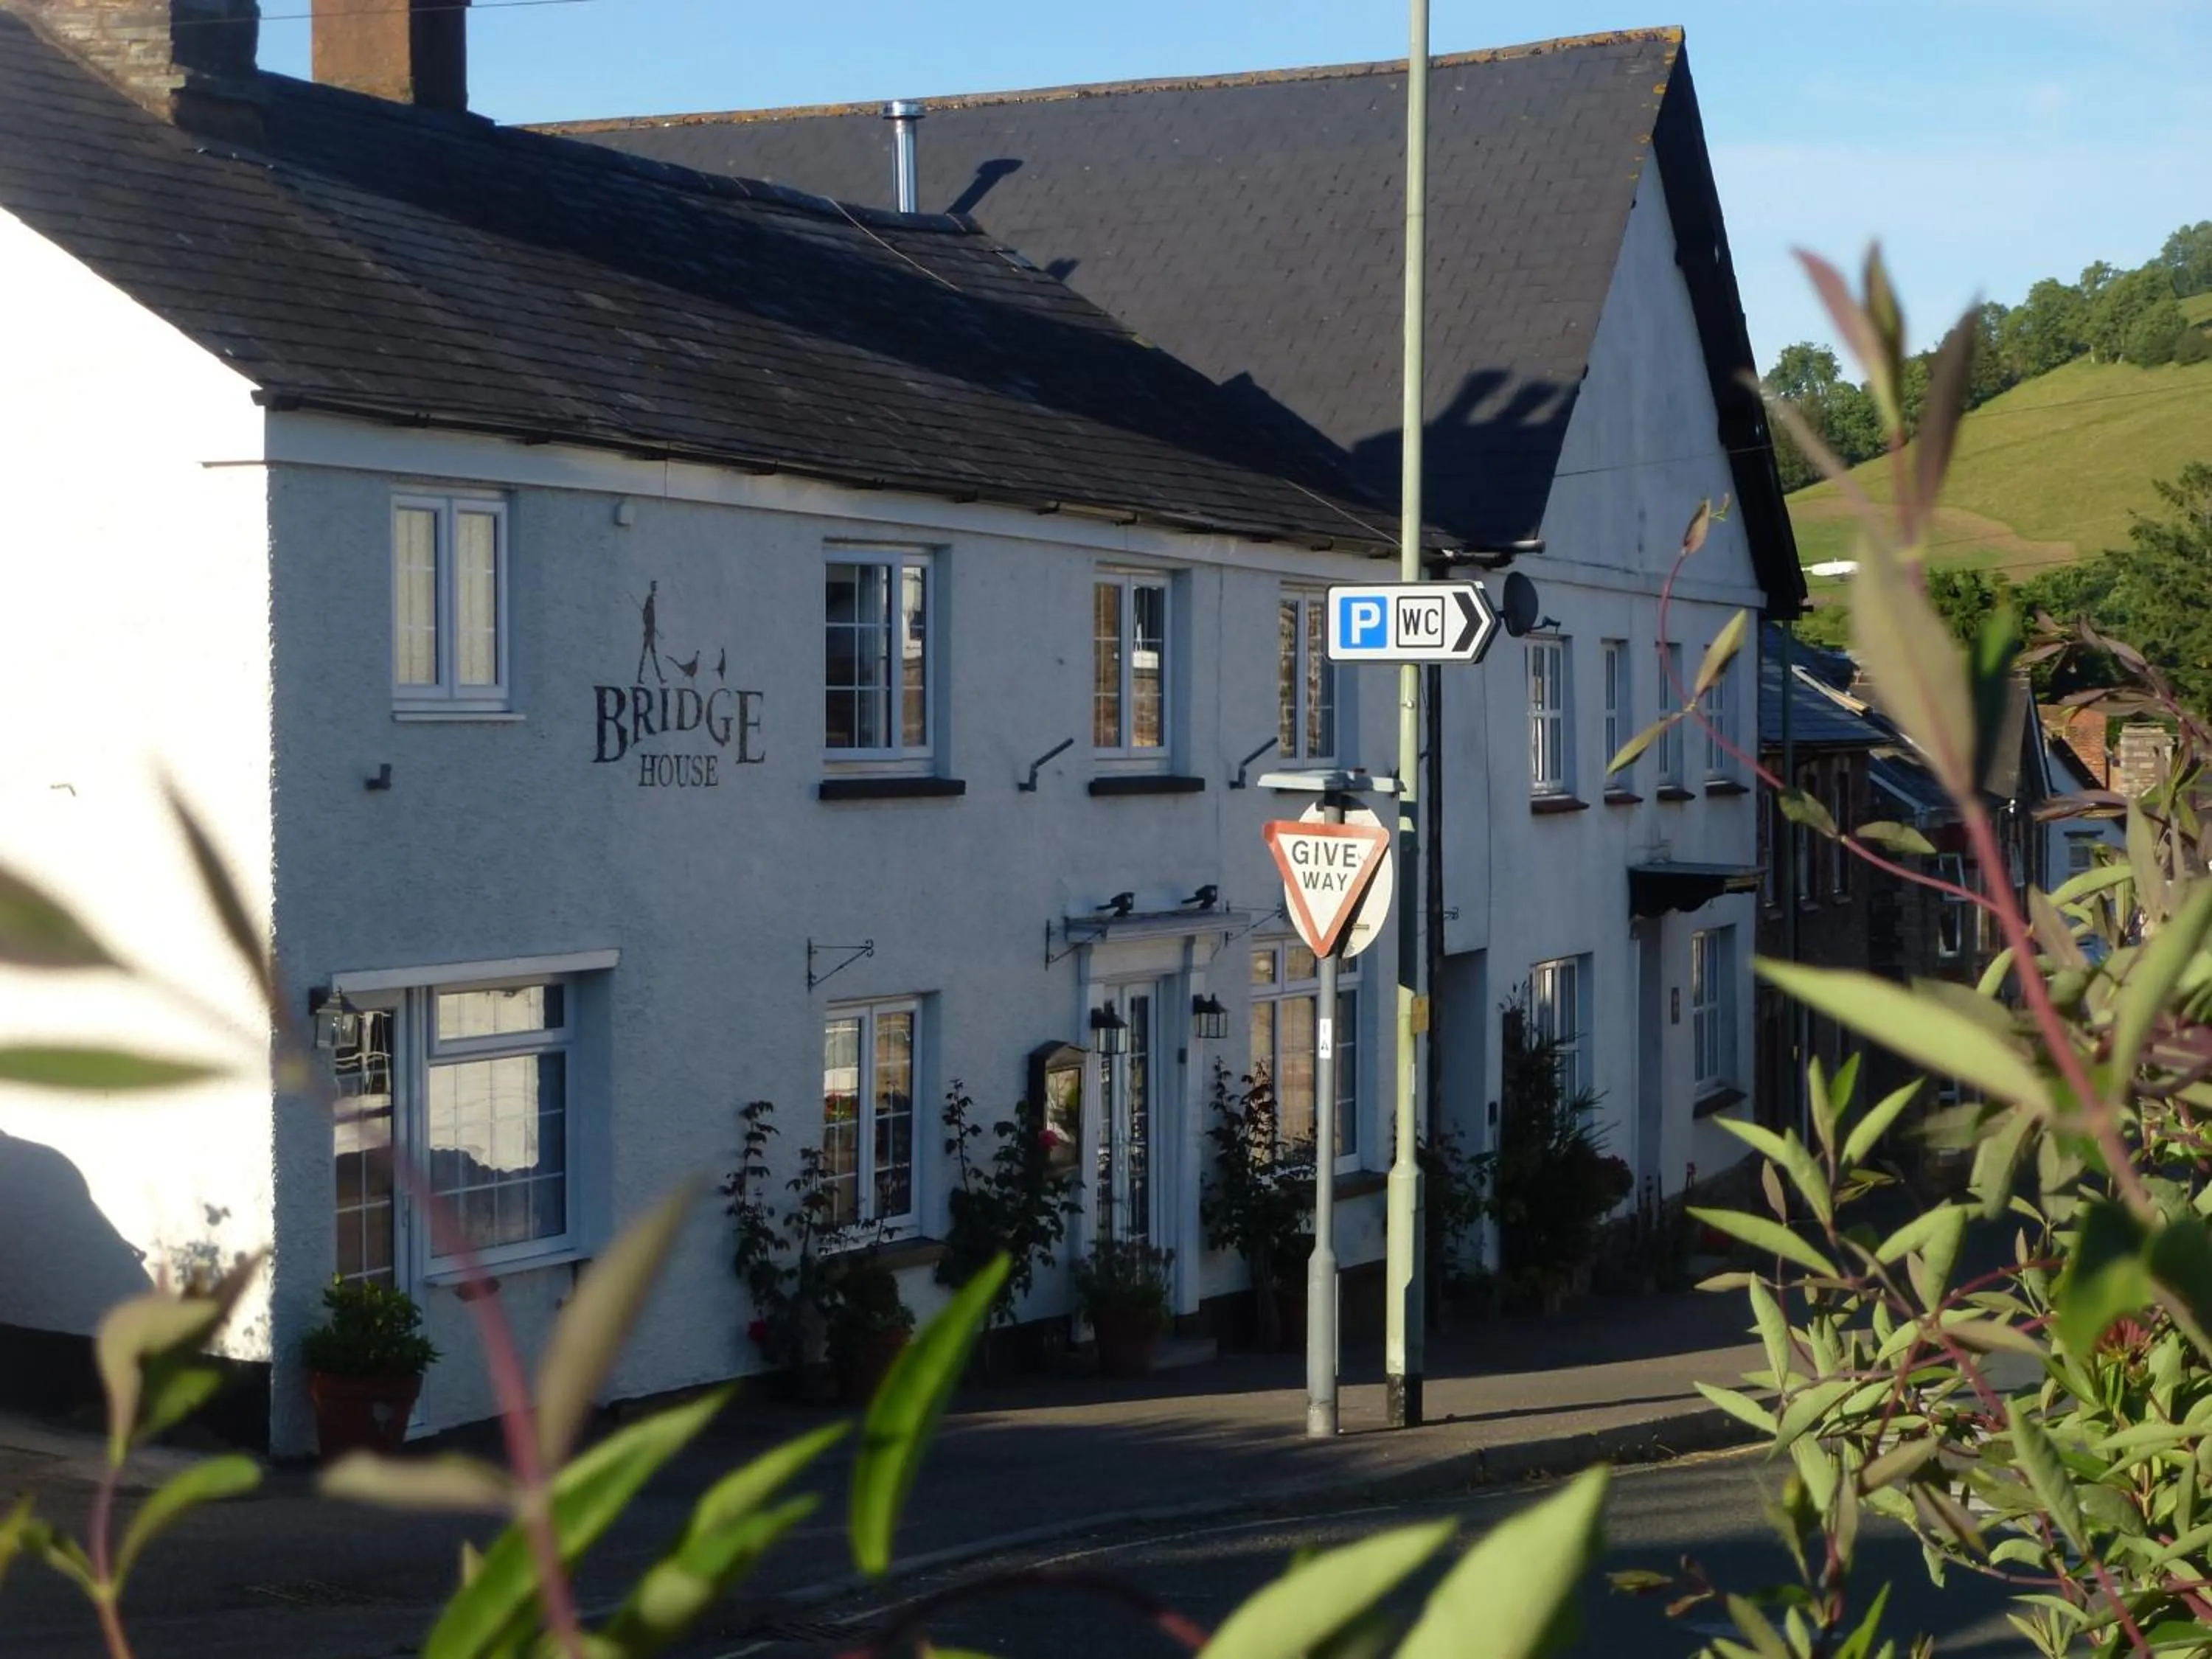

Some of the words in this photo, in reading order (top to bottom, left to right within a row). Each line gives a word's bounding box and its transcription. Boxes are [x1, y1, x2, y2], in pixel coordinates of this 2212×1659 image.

[1351, 602, 1381, 644] P
[1402, 608, 1439, 636] WC
[592, 685, 765, 764] BRIDGE
[639, 754, 718, 787] HOUSE
[1292, 840, 1357, 867] GIVE
[1302, 871, 1348, 891] WAY
